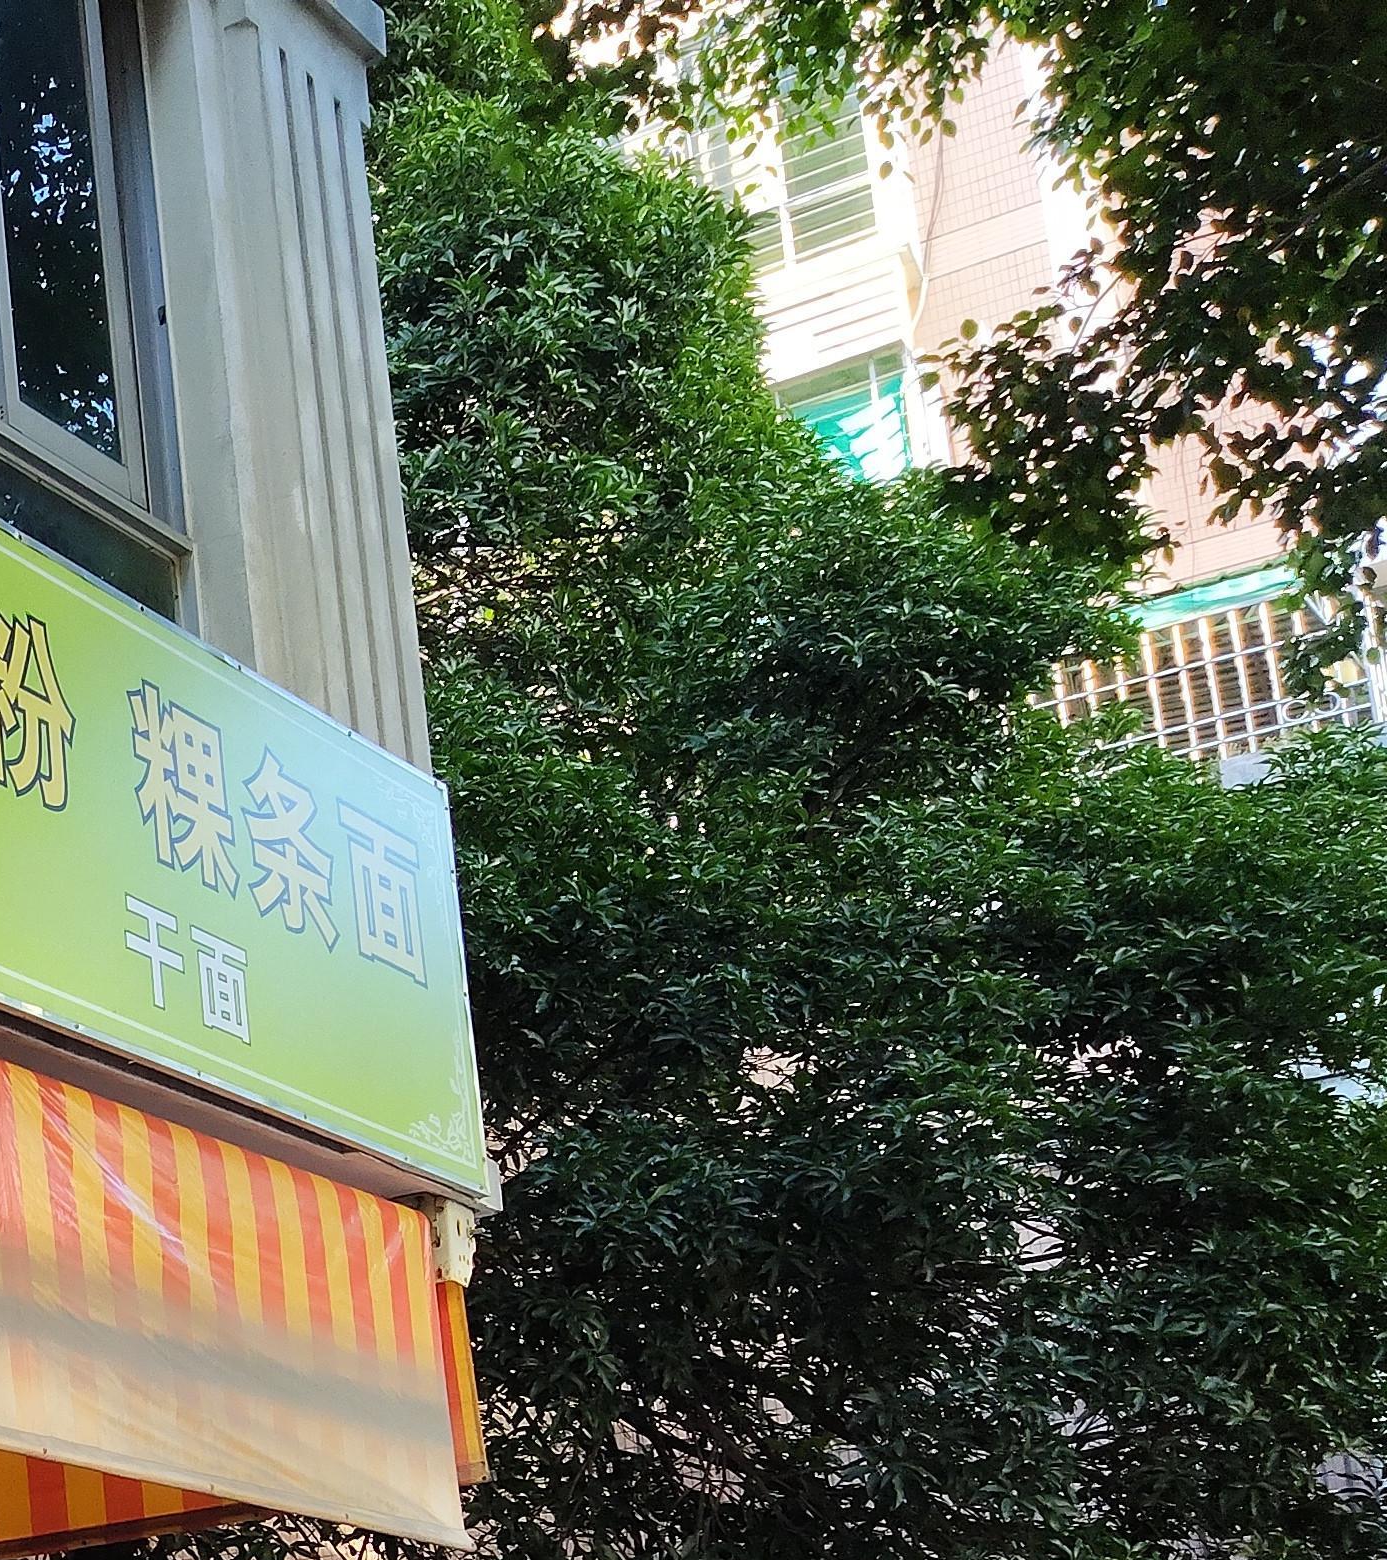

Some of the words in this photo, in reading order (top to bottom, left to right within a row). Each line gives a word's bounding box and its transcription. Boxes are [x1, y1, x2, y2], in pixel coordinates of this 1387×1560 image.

[130, 679, 431, 985] 粿条面
[121, 895, 252, 1044] 干面
